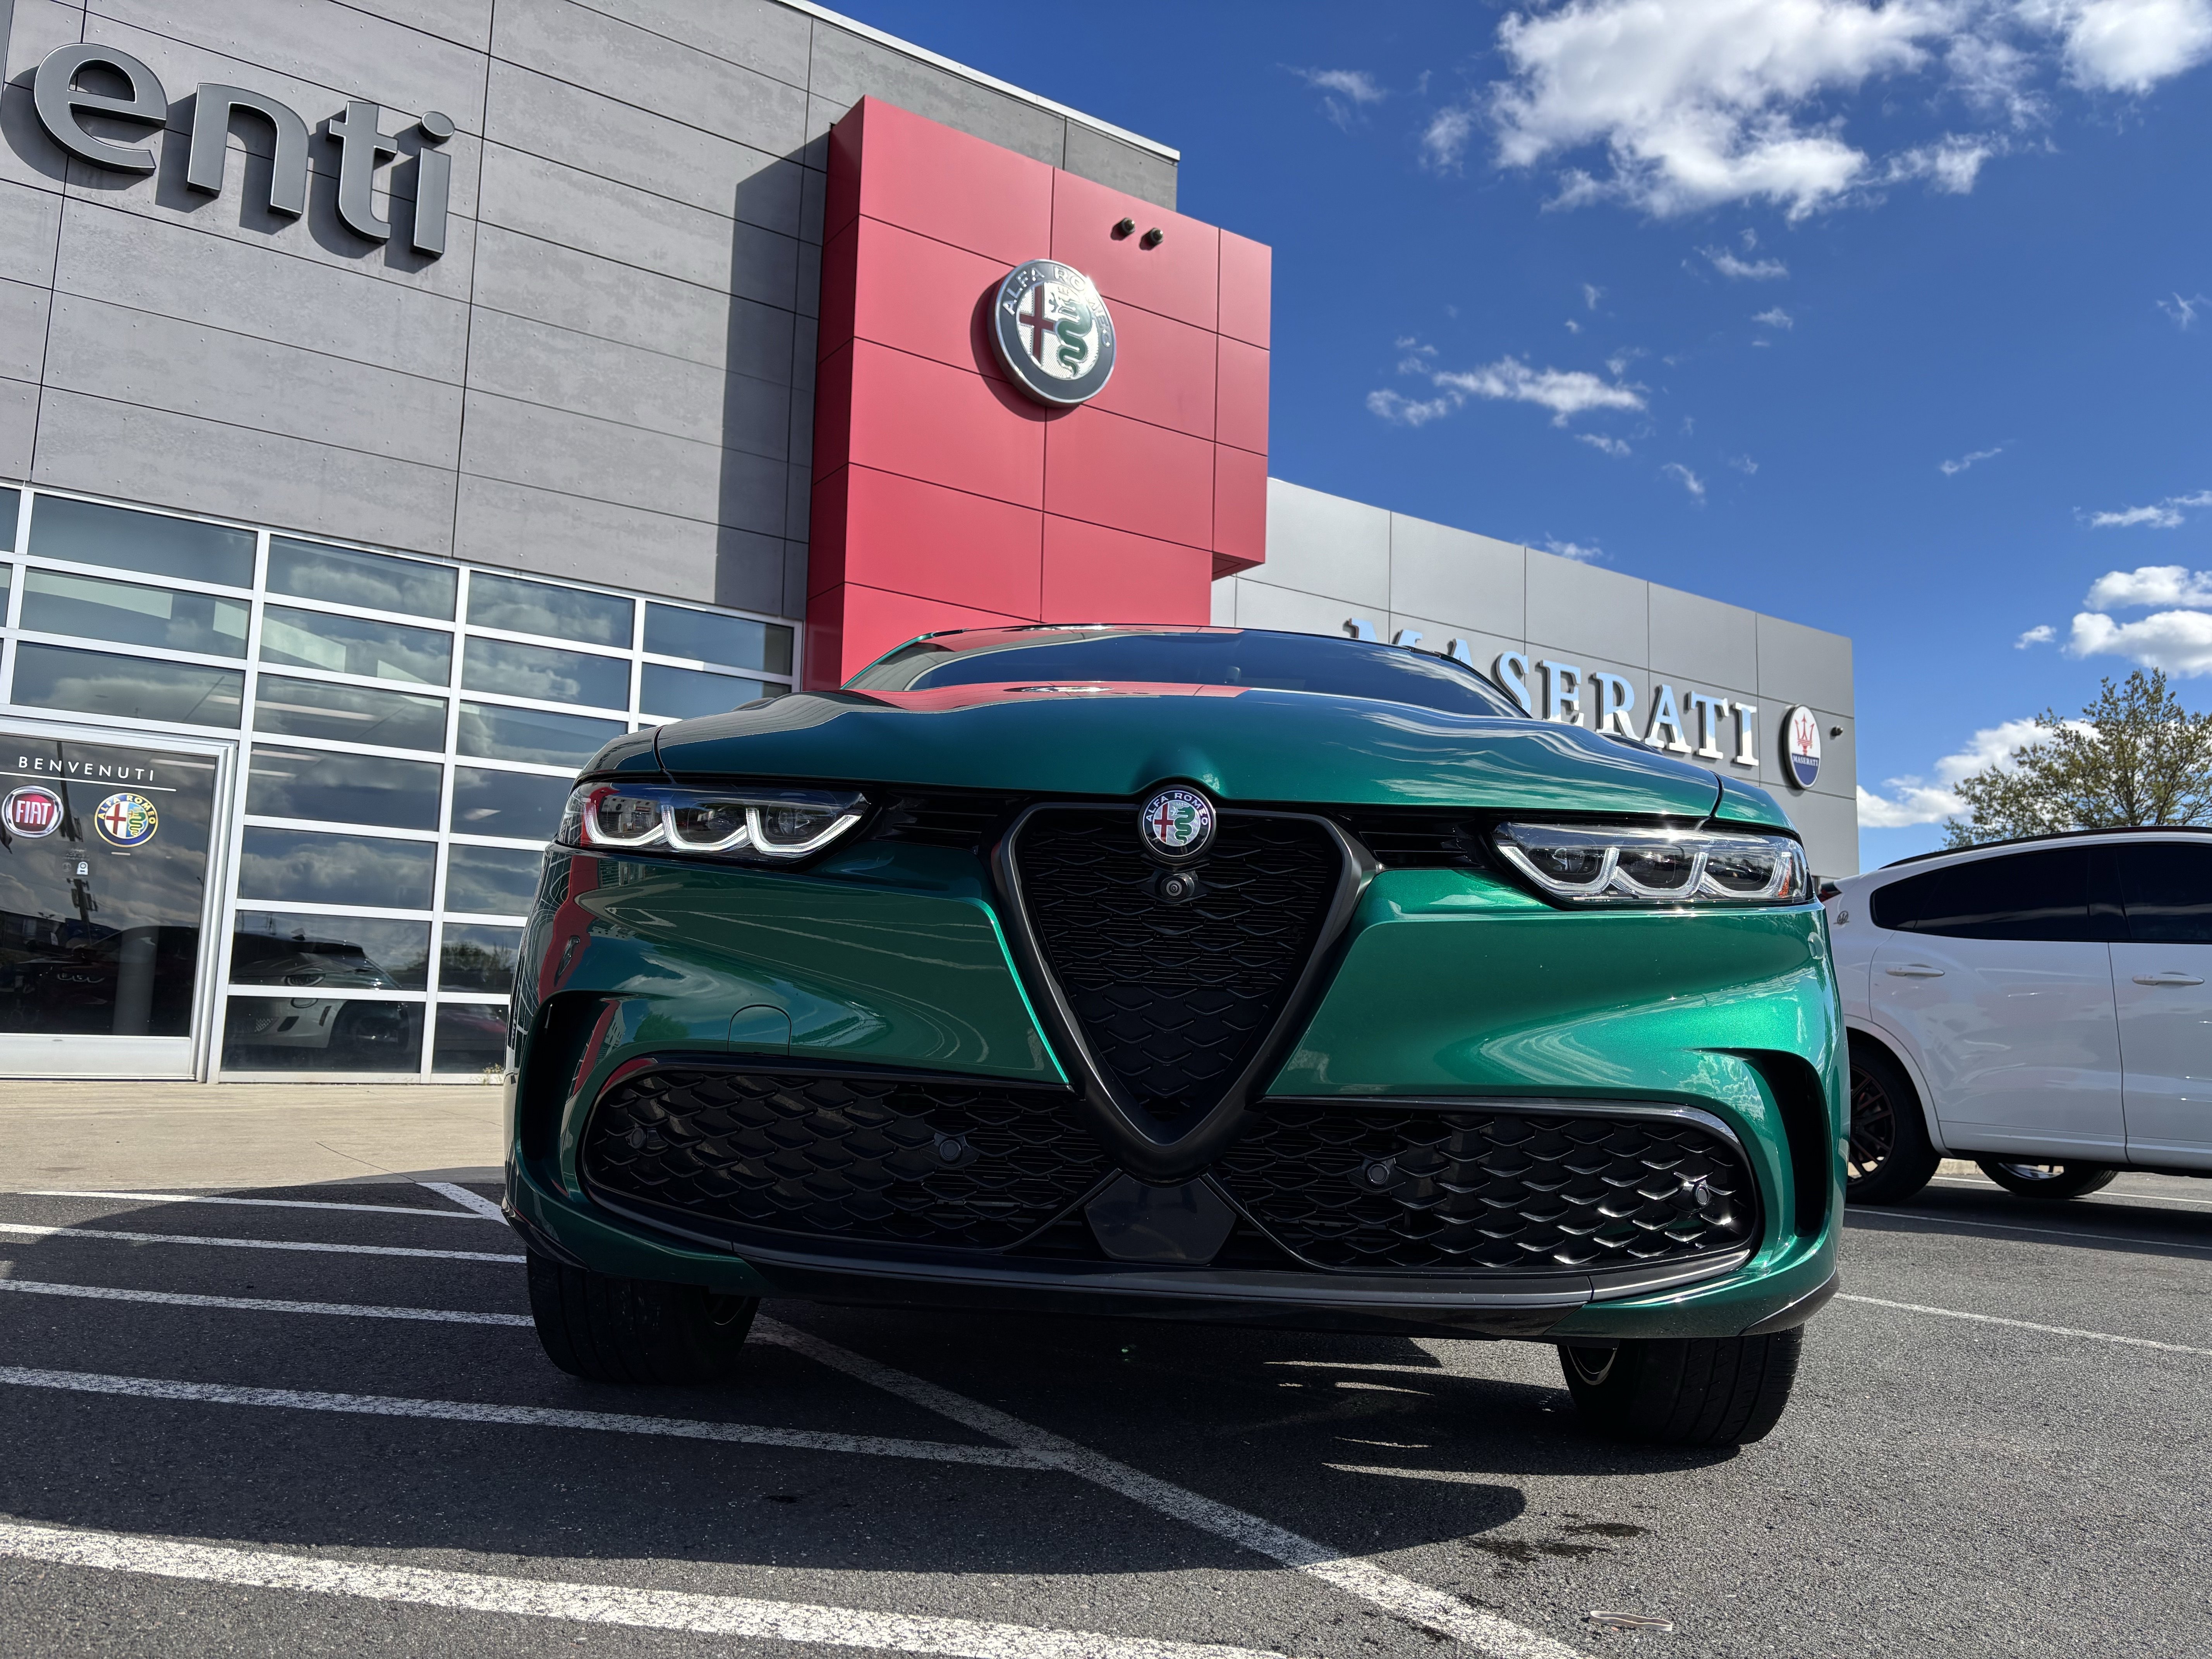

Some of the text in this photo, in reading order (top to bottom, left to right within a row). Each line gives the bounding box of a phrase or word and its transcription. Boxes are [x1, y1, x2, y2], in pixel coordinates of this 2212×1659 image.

[34, 43, 455, 259] enti
[1003, 266, 1111, 348] ALFA ROMEO
[1349, 617, 1759, 766] SERATI
[19, 756, 154, 781] BENVENUTI
[1793, 755, 1818, 766] MASERATI
[15, 800, 52, 825] FIAT
[98, 795, 156, 824] ALFA ROMEO
[1146, 793, 1208, 825] ALFA ROMEO
